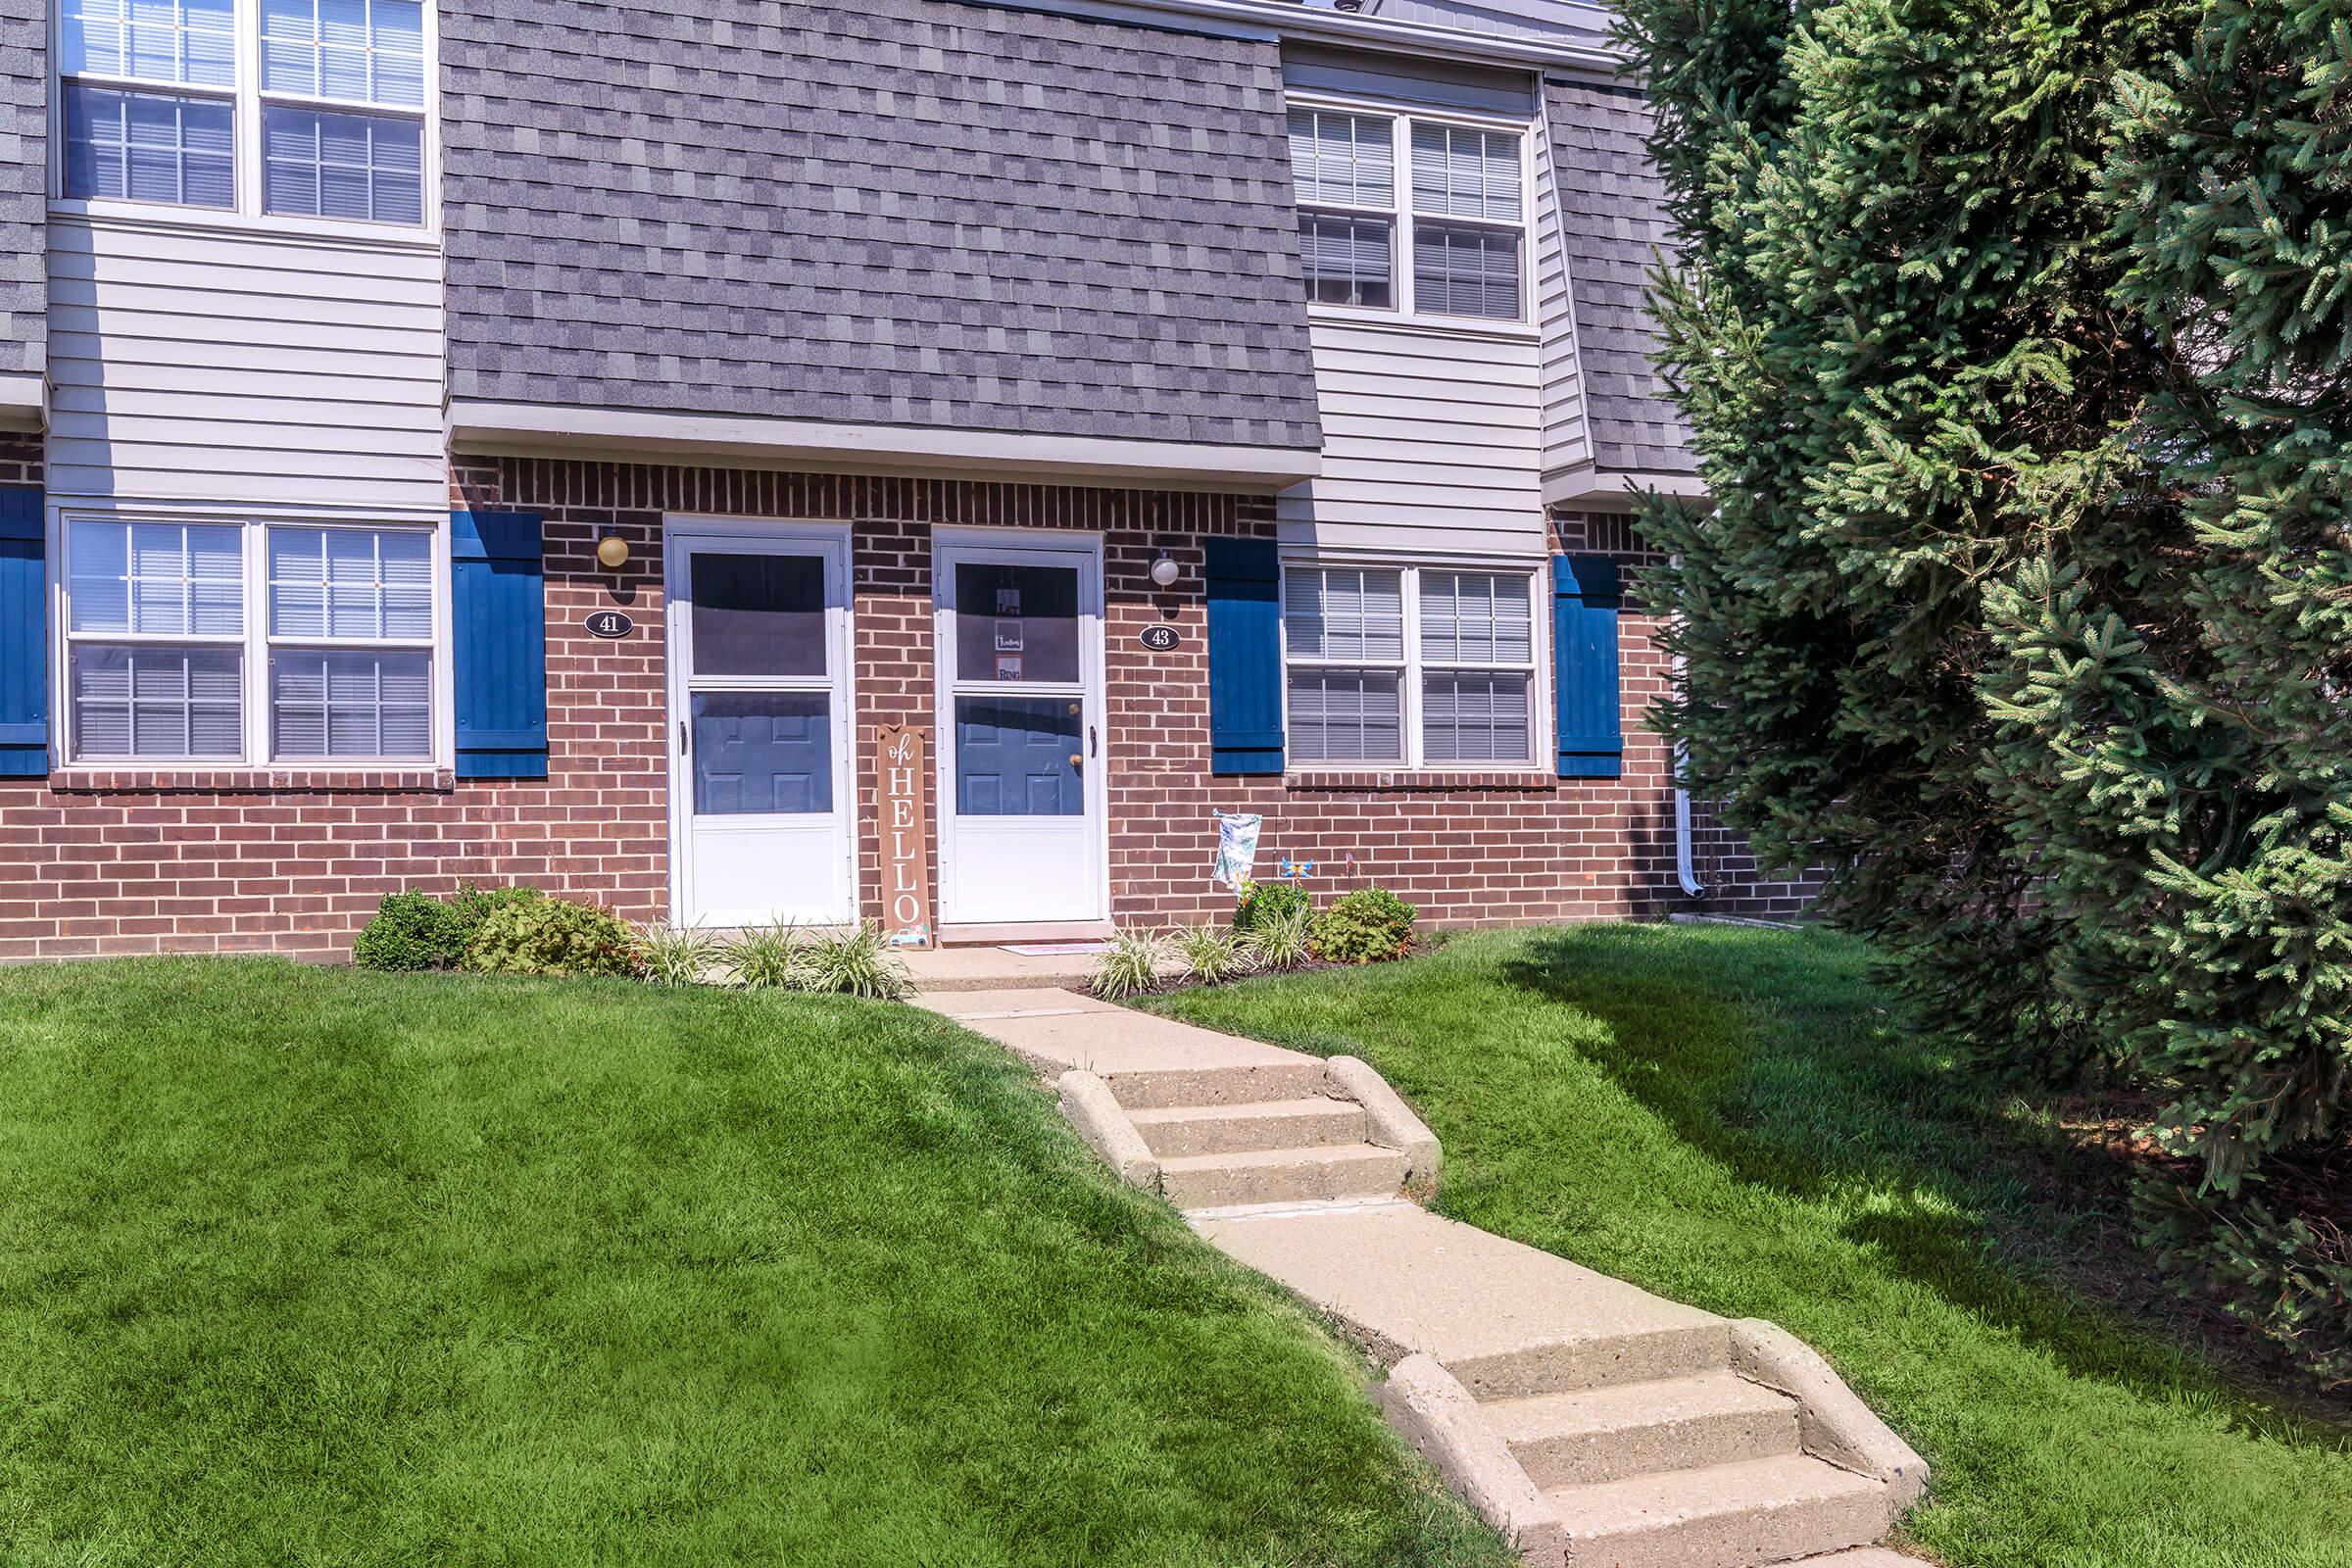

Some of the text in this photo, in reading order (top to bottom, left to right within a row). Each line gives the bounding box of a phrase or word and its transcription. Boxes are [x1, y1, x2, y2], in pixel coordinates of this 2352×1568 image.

[599, 614, 619, 632] 41
[1152, 629, 1169, 645] 43
[888, 733, 914, 766] oh
[887, 767, 919, 923] HELLO
